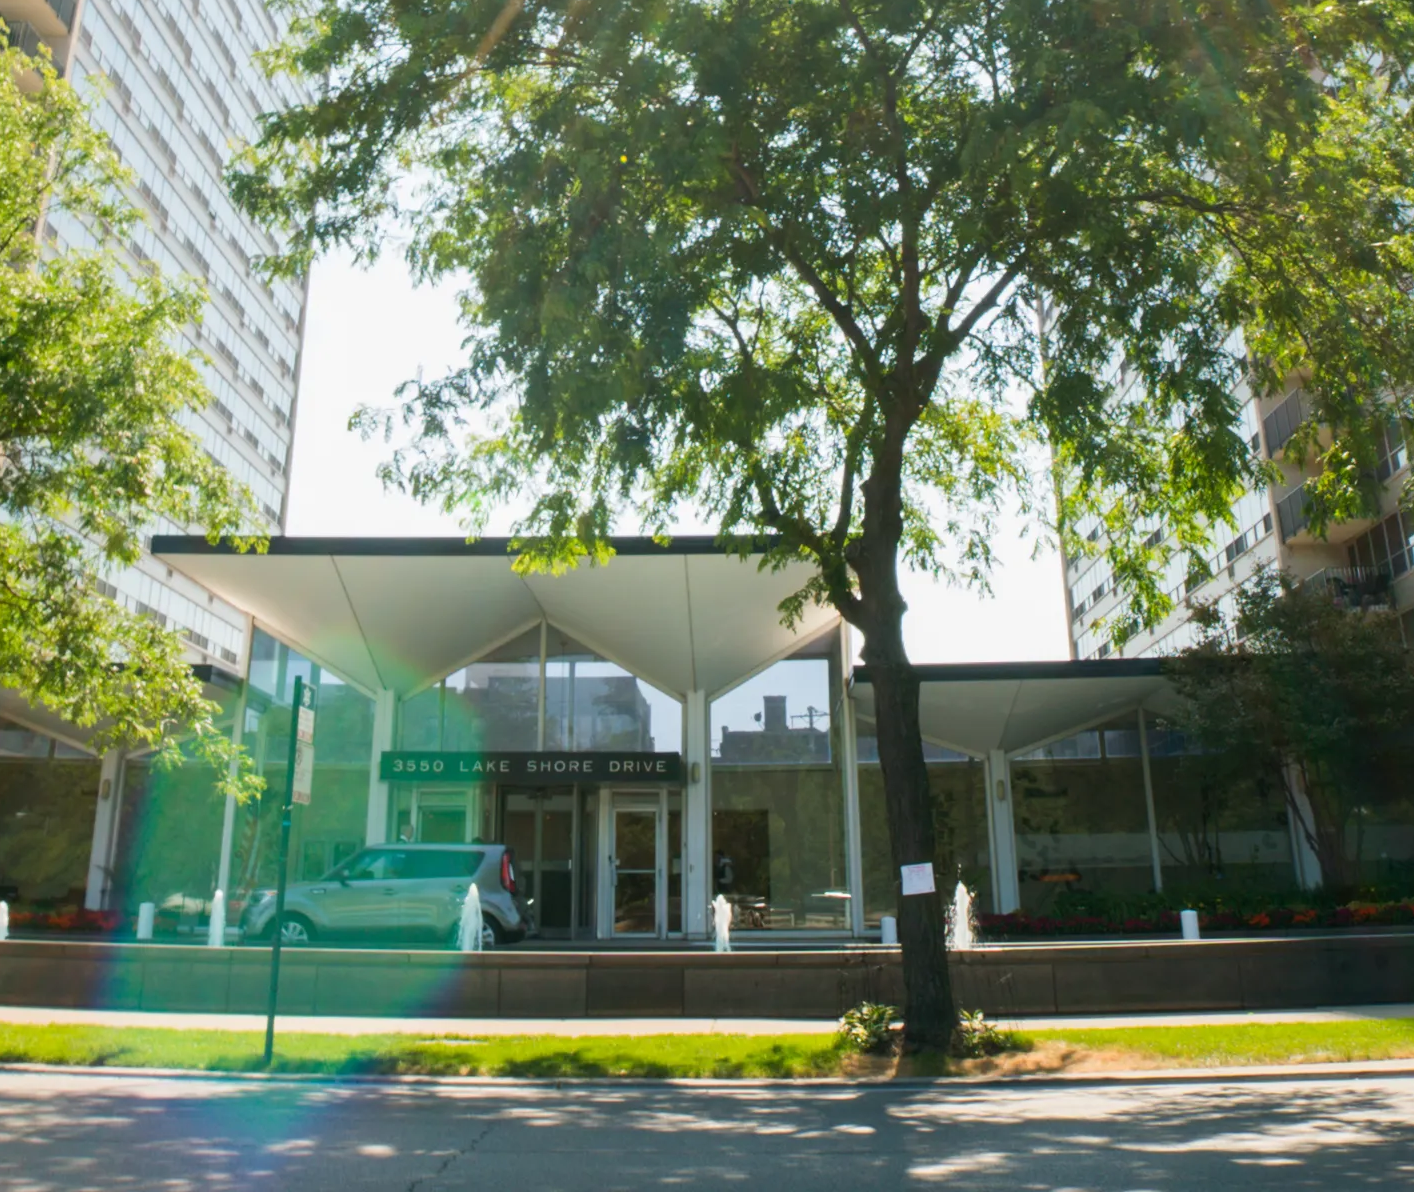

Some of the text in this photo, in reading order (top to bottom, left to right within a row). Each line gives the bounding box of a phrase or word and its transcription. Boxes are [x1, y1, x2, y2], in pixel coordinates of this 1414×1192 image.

[392, 759, 667, 773] 3550 LAKE SHORE DRIVE
